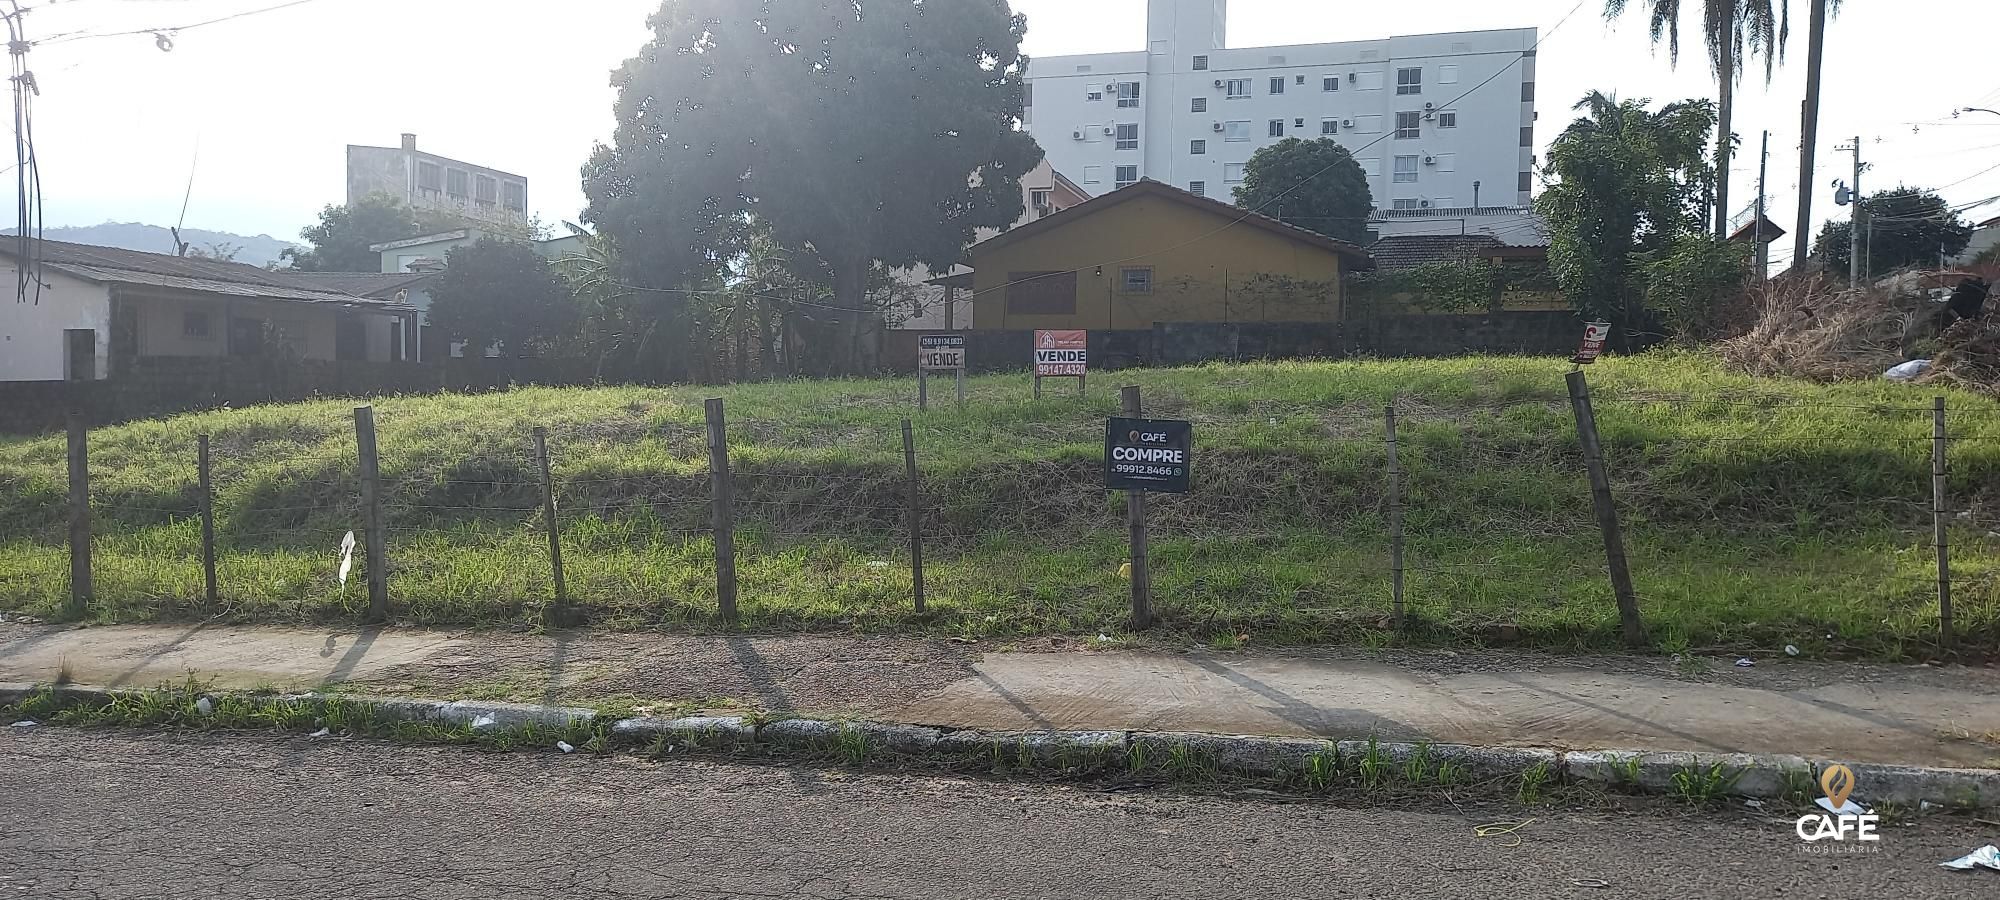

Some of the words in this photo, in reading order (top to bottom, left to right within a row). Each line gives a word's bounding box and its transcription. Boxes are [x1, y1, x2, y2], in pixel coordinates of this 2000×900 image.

[927, 352, 959, 366] VENDE
[1037, 351, 1086, 362] VENDE
[1038, 364, 1086, 375] 99147.4320
[1141, 431, 1167, 443] CAFÉ
[1112, 446, 1183, 464] COMPRE
[1116, 464, 1172, 476] 99912.8466
